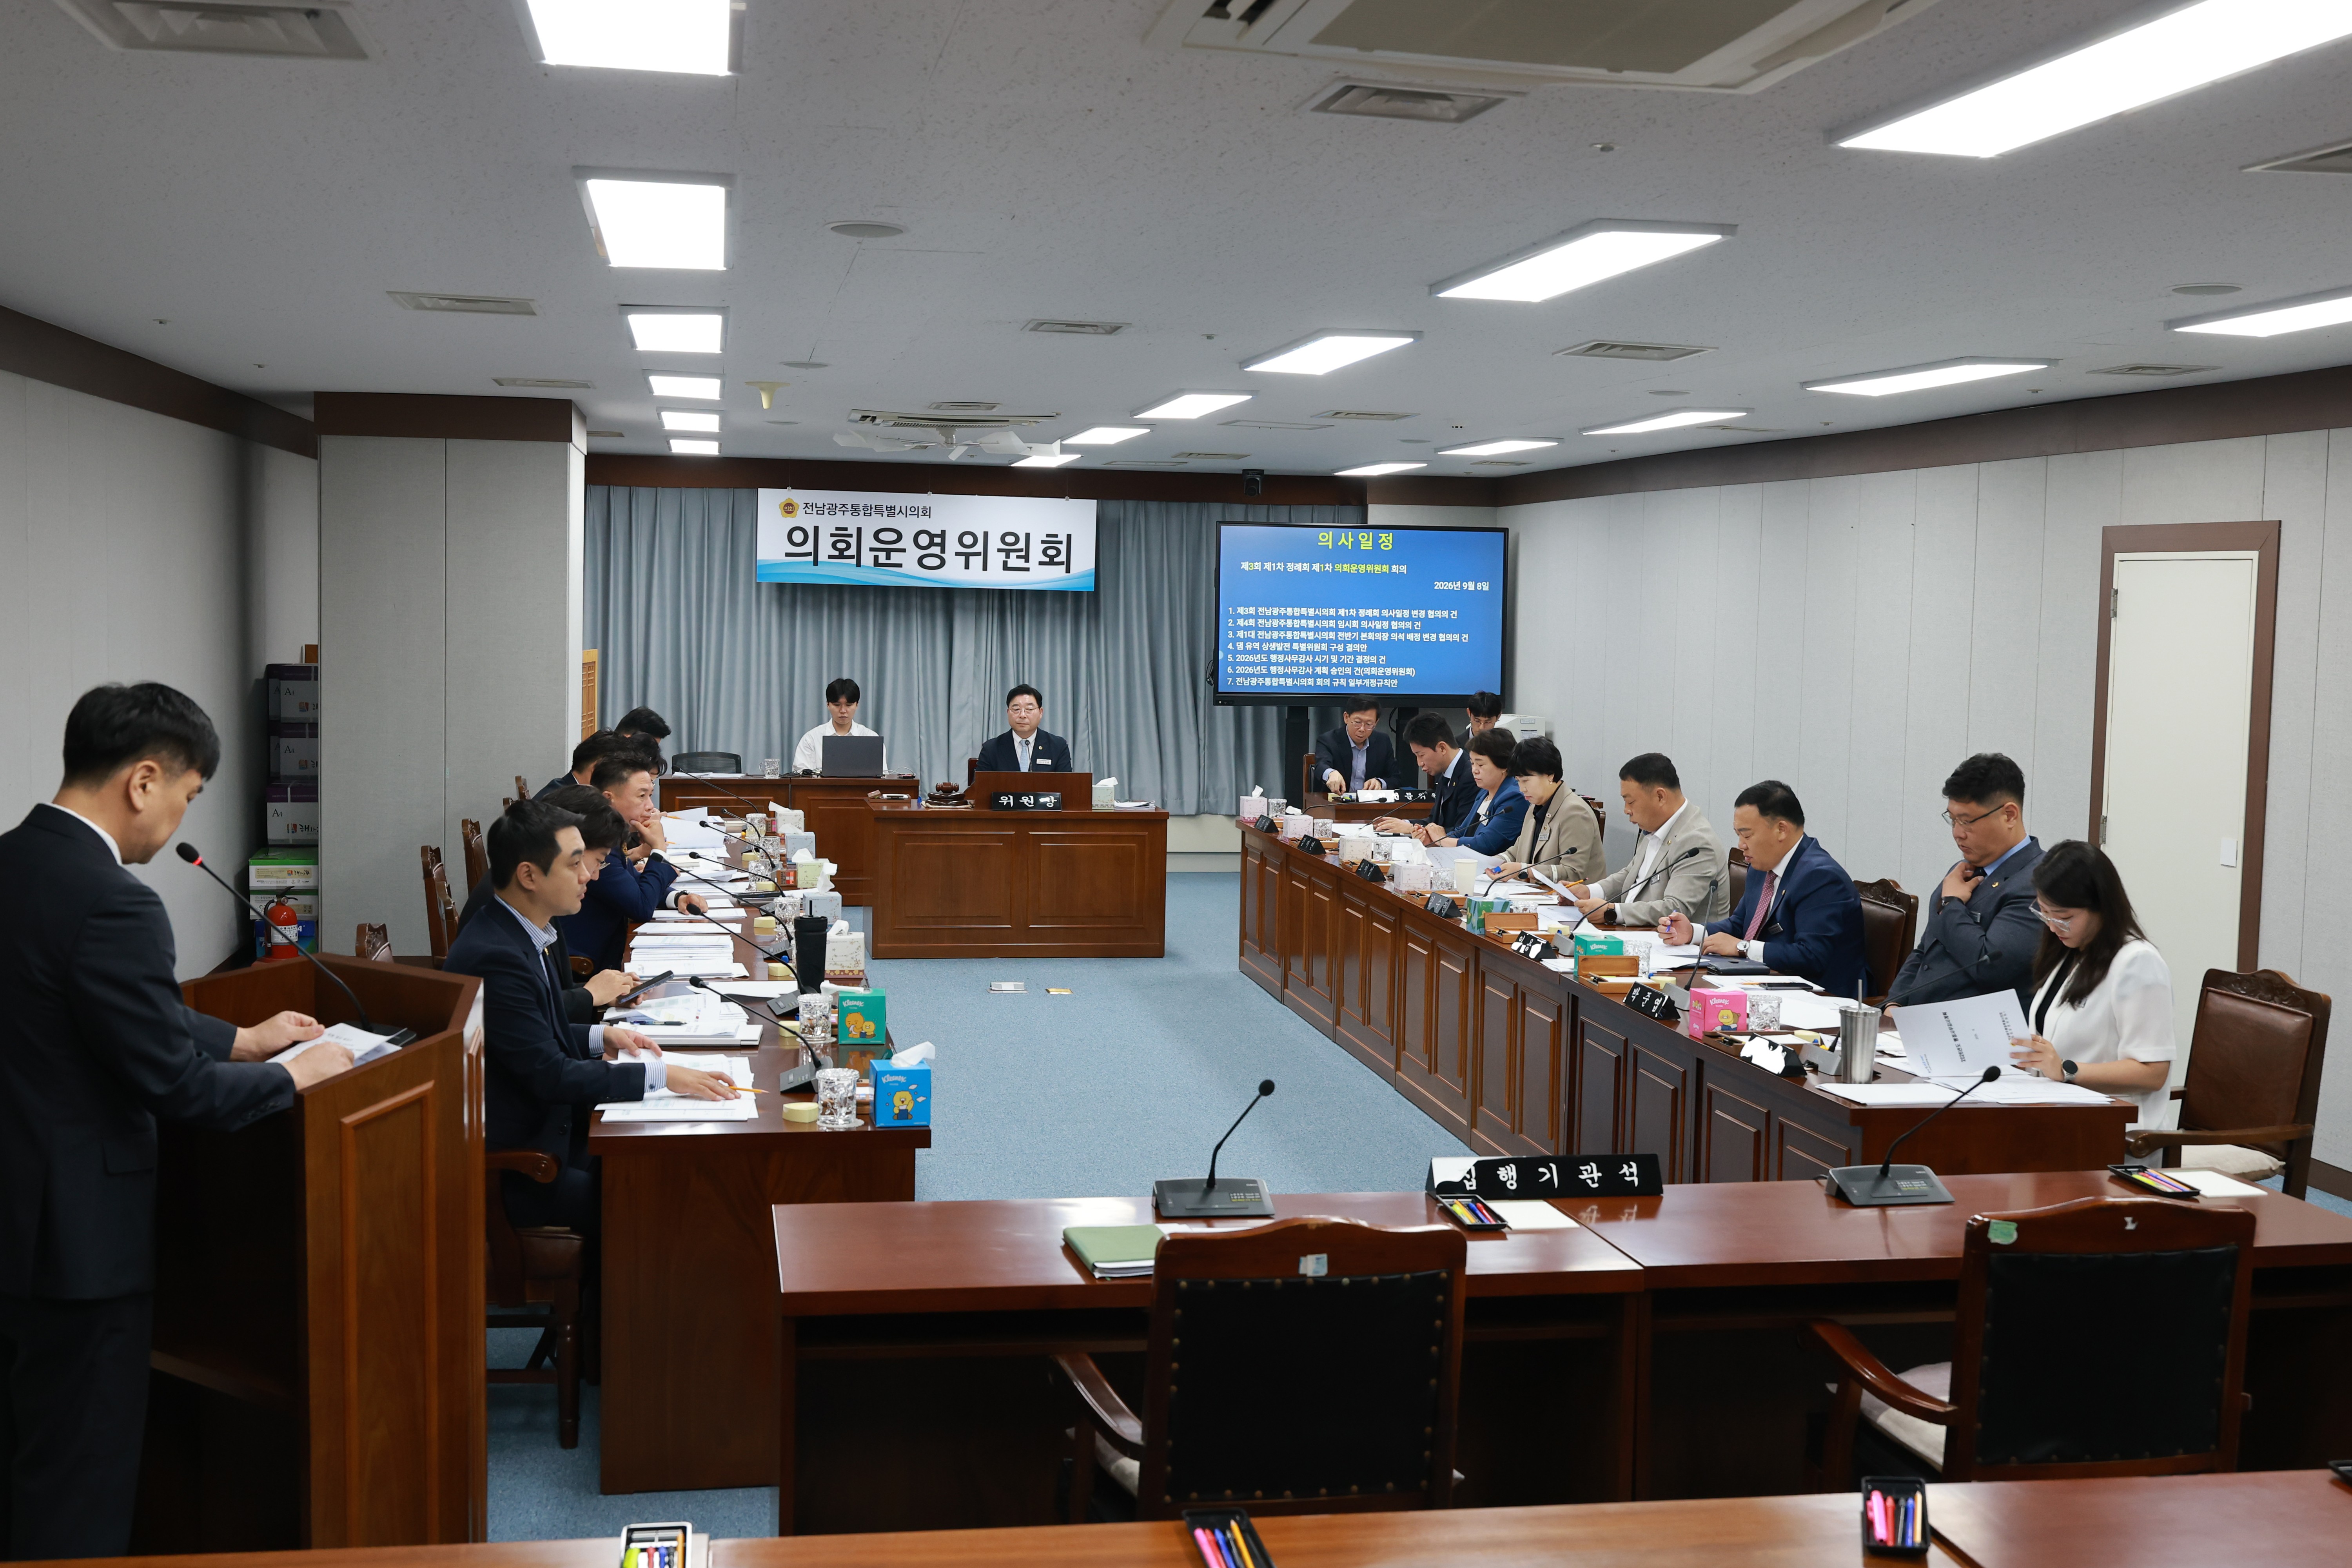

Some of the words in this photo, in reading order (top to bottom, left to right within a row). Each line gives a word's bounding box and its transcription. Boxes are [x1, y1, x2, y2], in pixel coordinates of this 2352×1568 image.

[803, 502, 931, 519] 전남광주통합특별시의회
[1318, 531, 1393, 550] 의사일정
[785, 525, 1072, 573] 의회운영위원회
[1241, 561, 1261, 571] 제3회
[1263, 562, 1284, 571] 제1차
[1286, 563, 1309, 572] 정례회
[1312, 563, 1332, 572] 제1차
[1334, 564, 1388, 573] 의회운영위원회
[1391, 565, 1406, 574] 회의
[1434, 581, 1460, 590] 2026년
[1463, 581, 1474, 590] 9월
[1477, 582, 1488, 590] 8일
[1237, 607, 1255, 615] 제3회
[1258, 607, 1336, 616] 전남광주통합특별시의회
[1338, 608, 1356, 617] 제1차
[1358, 609, 1379, 617] 정례회
[1381, 609, 1409, 617] 의사일정
[1412, 610, 1425, 618] 변경
[1428, 610, 1448, 618] 협의의
[1237, 619, 1255, 627] 제4회
[1258, 619, 1335, 628] 전남광주통합특별시의회
[1338, 620, 1358, 628] 임시회
[1361, 621, 1388, 629] 의사일정
[1391, 621, 1412, 629] 협의의
[1236, 630, 1255, 639] 제1대
[1258, 631, 1335, 640] 전남광주통합특별시의회
[1338, 632, 1358, 640] 전반기
[1361, 632, 1389, 641] 본회의장
[1391, 633, 1405, 641] 의석
[1423, 633, 1436, 641] 변경
[1439, 633, 1459, 642] 협의의
[1236, 642, 1243, 650] 댐
[1245, 642, 1259, 650] 유역
[1262, 642, 1290, 650] 상생발전
[1292, 643, 1327, 651] 특별위원회
[1330, 643, 1343, 652] 구성
[1346, 644, 1367, 652] 결의안
[1236, 654, 1268, 662] 2026년도
[1270, 654, 1313, 663] 행정사무감사
[1314, 655, 1328, 663] 시기
[1340, 655, 1354, 663] 기간
[1356, 655, 1376, 664] 결정의
[1270, 666, 1312, 674] 행정사무감사
[1314, 666, 1328, 675] 계획
[1330, 667, 1351, 675] 승인의
[1354, 667, 1415, 677] 건(의회운영위원회)
[1236, 677, 1314, 686] 전남광주통합특별시의회
[1316, 678, 1330, 686] 회의
[1348, 679, 1397, 687] 일부개정규칙안
[998, 795, 1057, 807] 위원장
[1632, 987, 1662, 1012] 박준엽
[1709, 997, 1729, 1005] Kleenex
[882, 1074, 907, 1083] Kleenex
[1457, 1161, 1639, 1191] 집행기관석
